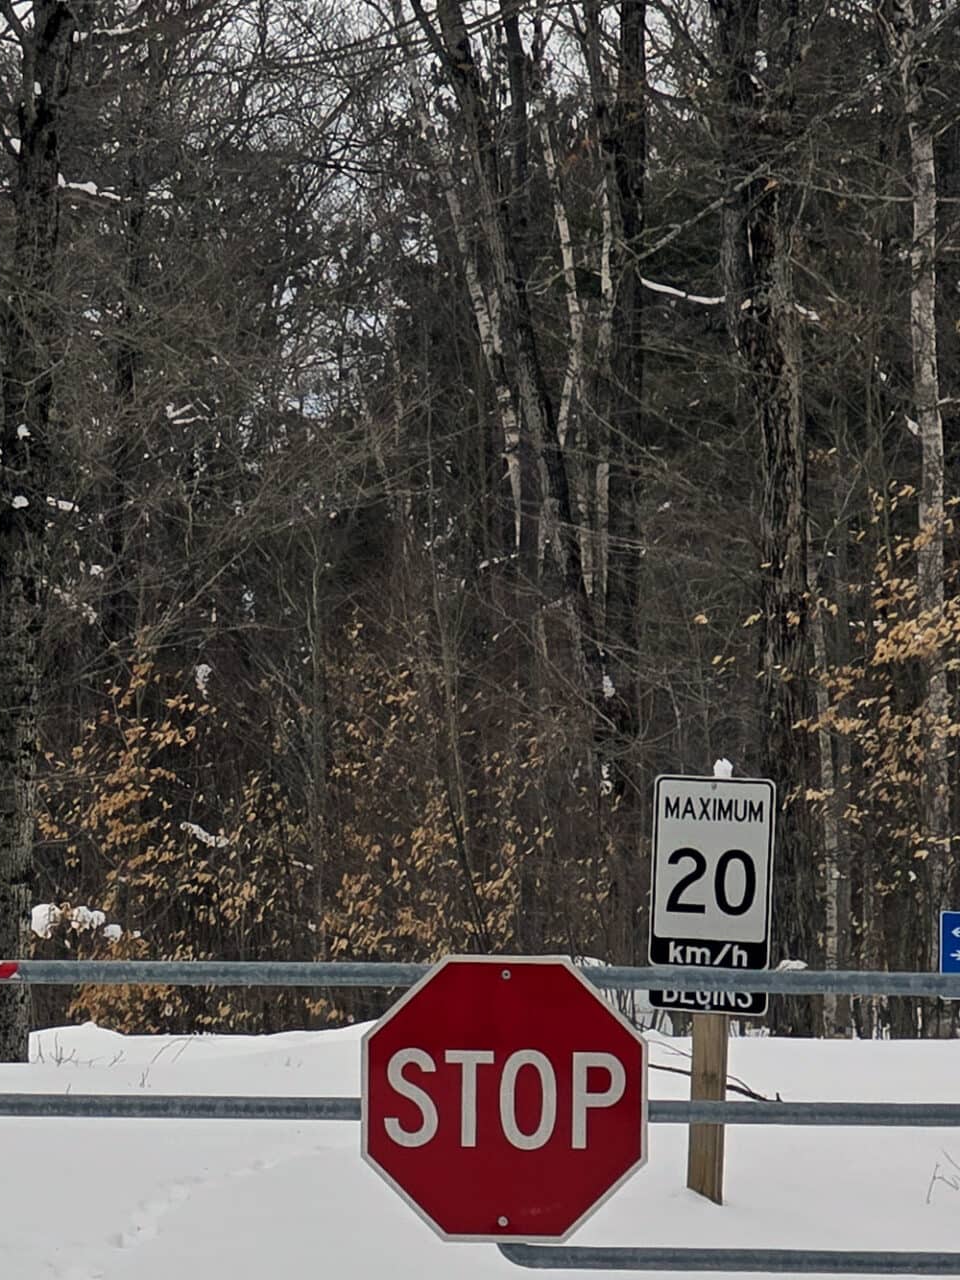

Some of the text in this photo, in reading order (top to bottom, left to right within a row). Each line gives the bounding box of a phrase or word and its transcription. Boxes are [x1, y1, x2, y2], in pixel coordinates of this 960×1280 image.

[665, 797, 764, 823] MAXIMUM
[666, 847, 756, 916] 20
[668, 941, 748, 967] km/h
[383, 1047, 627, 1151] STOP
